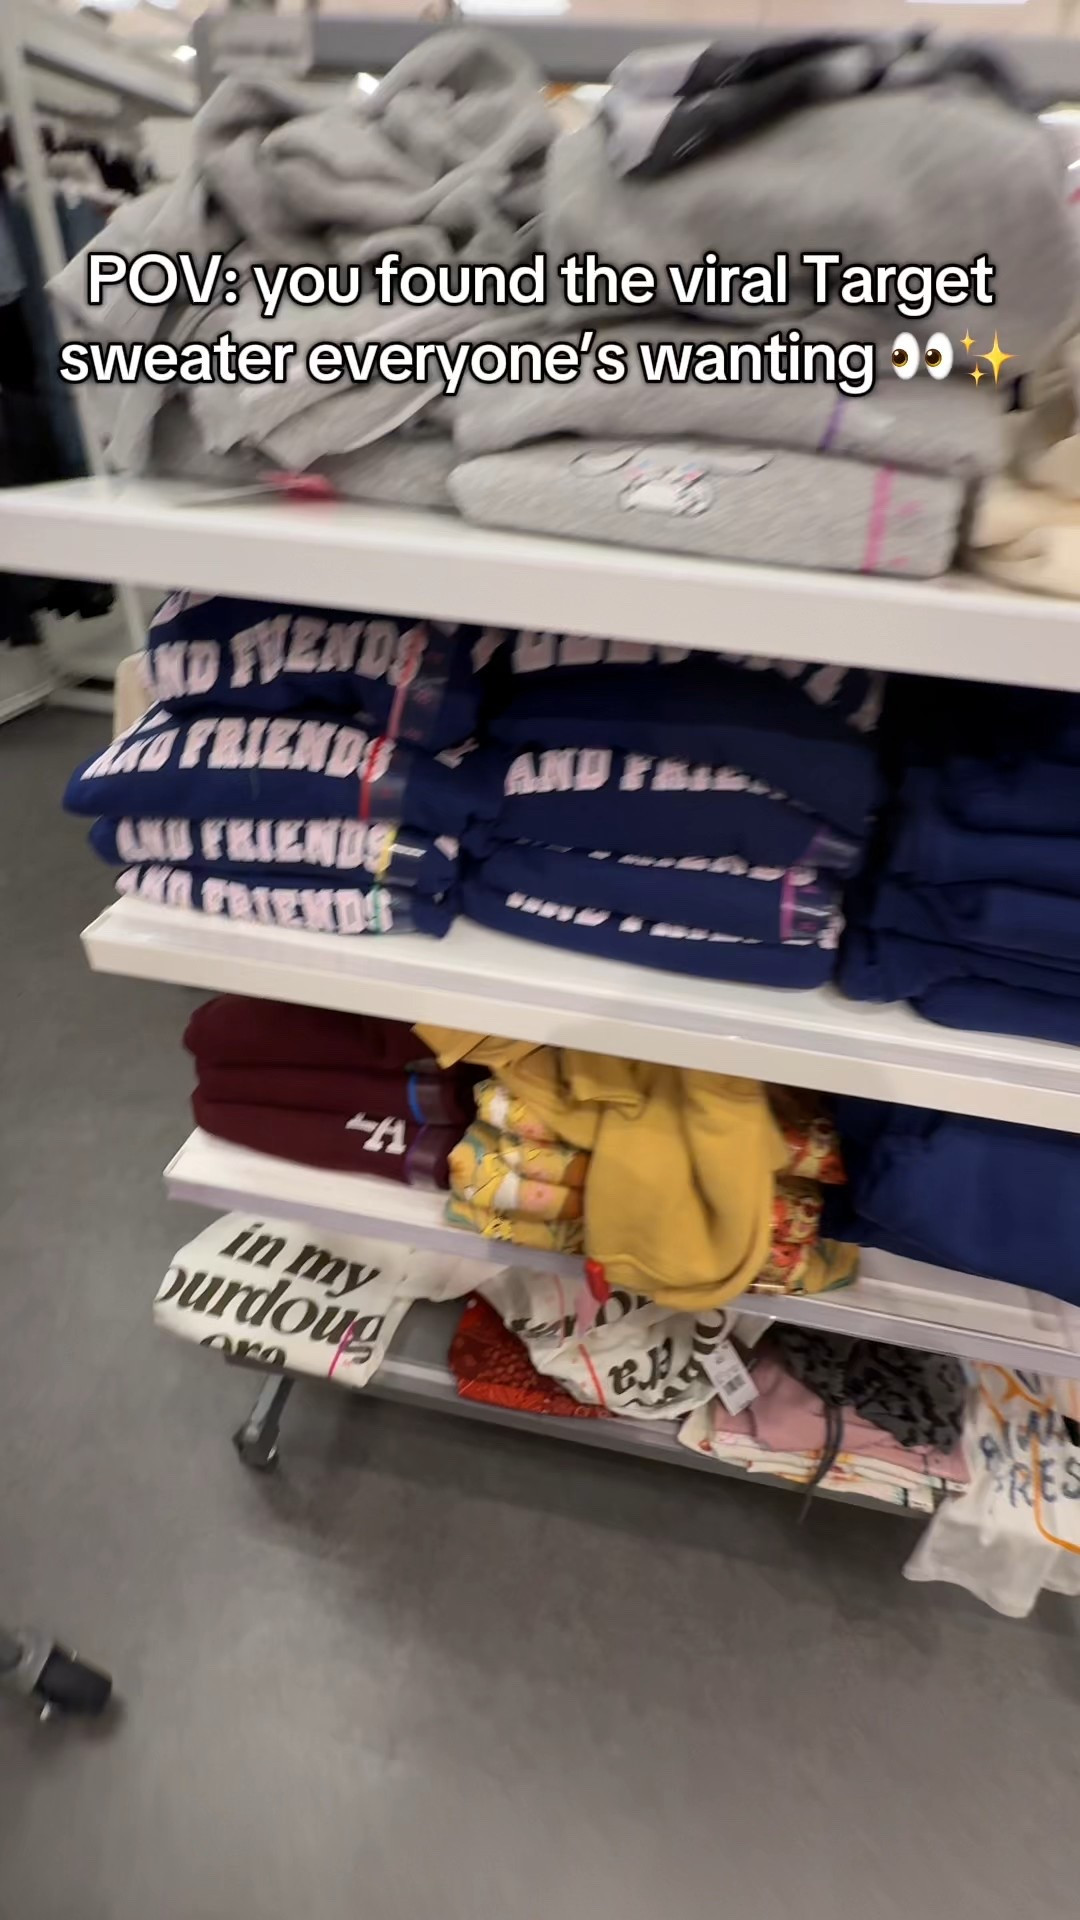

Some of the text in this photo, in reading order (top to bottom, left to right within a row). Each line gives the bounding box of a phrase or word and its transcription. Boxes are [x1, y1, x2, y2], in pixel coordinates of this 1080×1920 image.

[179, 716, 397, 783] FRIENDS
[504, 747, 613, 796] AND
[201, 816, 398, 875] FRIENDS
[217, 1221, 382, 1299] in my
